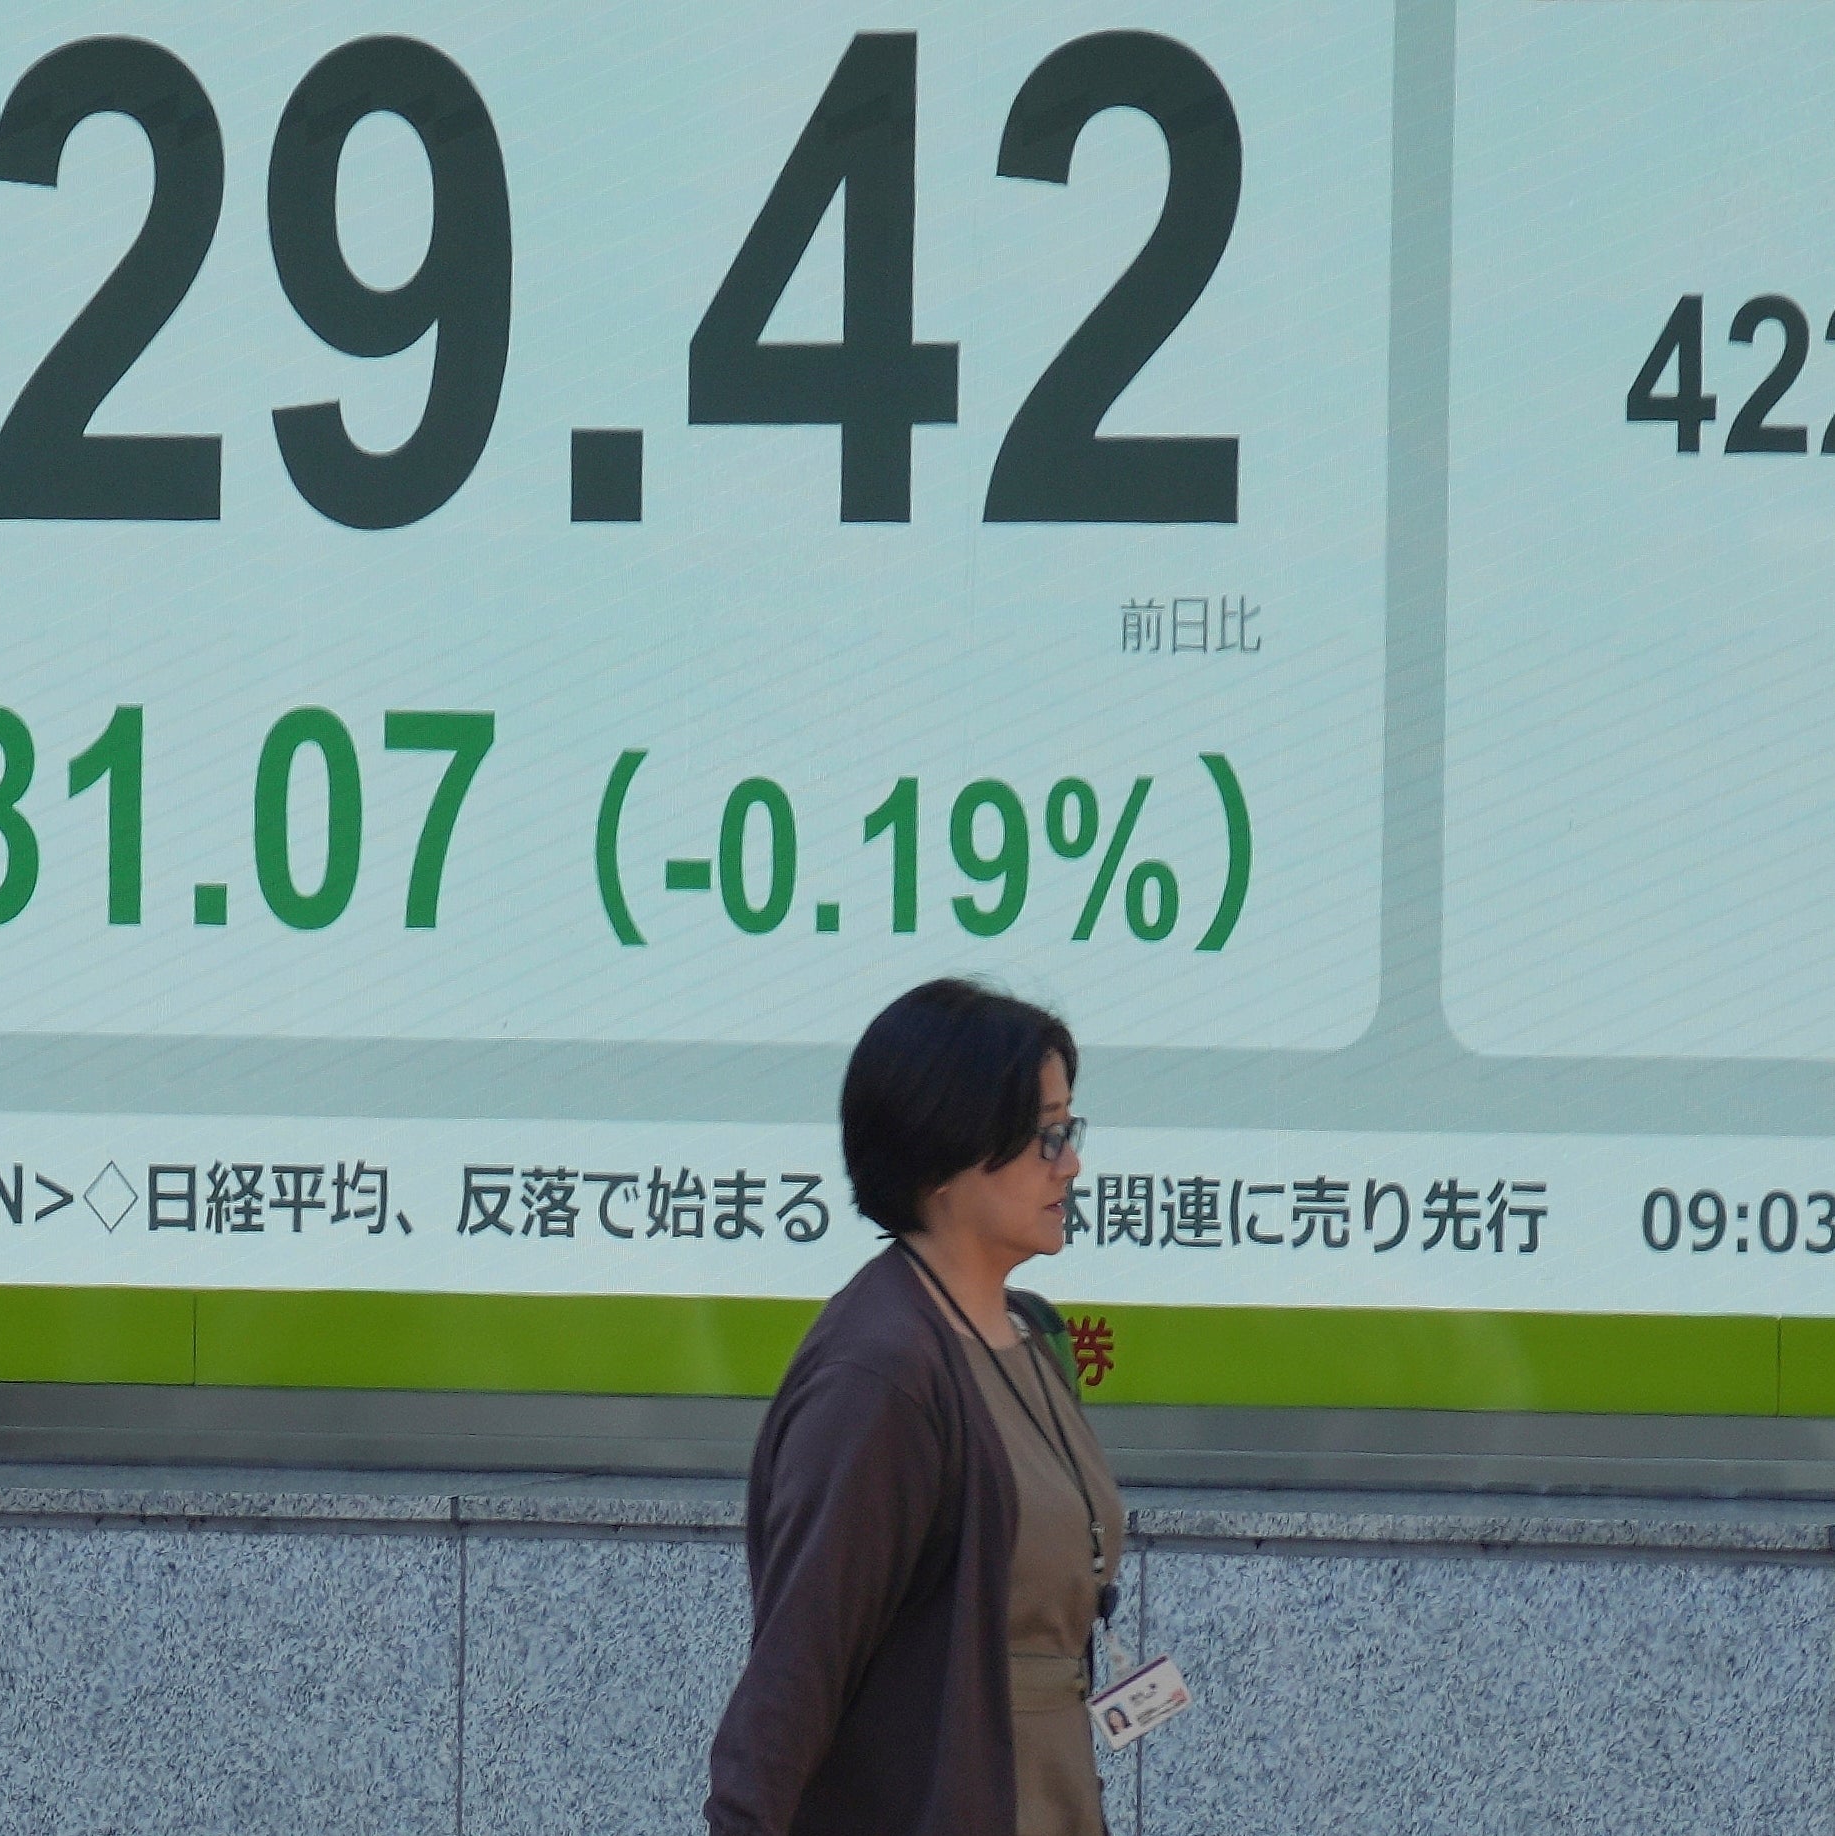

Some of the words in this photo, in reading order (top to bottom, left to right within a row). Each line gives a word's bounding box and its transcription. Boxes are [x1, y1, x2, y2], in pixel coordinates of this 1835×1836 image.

[1624, 293, 1835, 456] 42
[1120, 594, 1263, 657] 前日比
[592, 747, 1255, 955] (-0.19%)
[1640, 1186, 1835, 1255] 09:03
